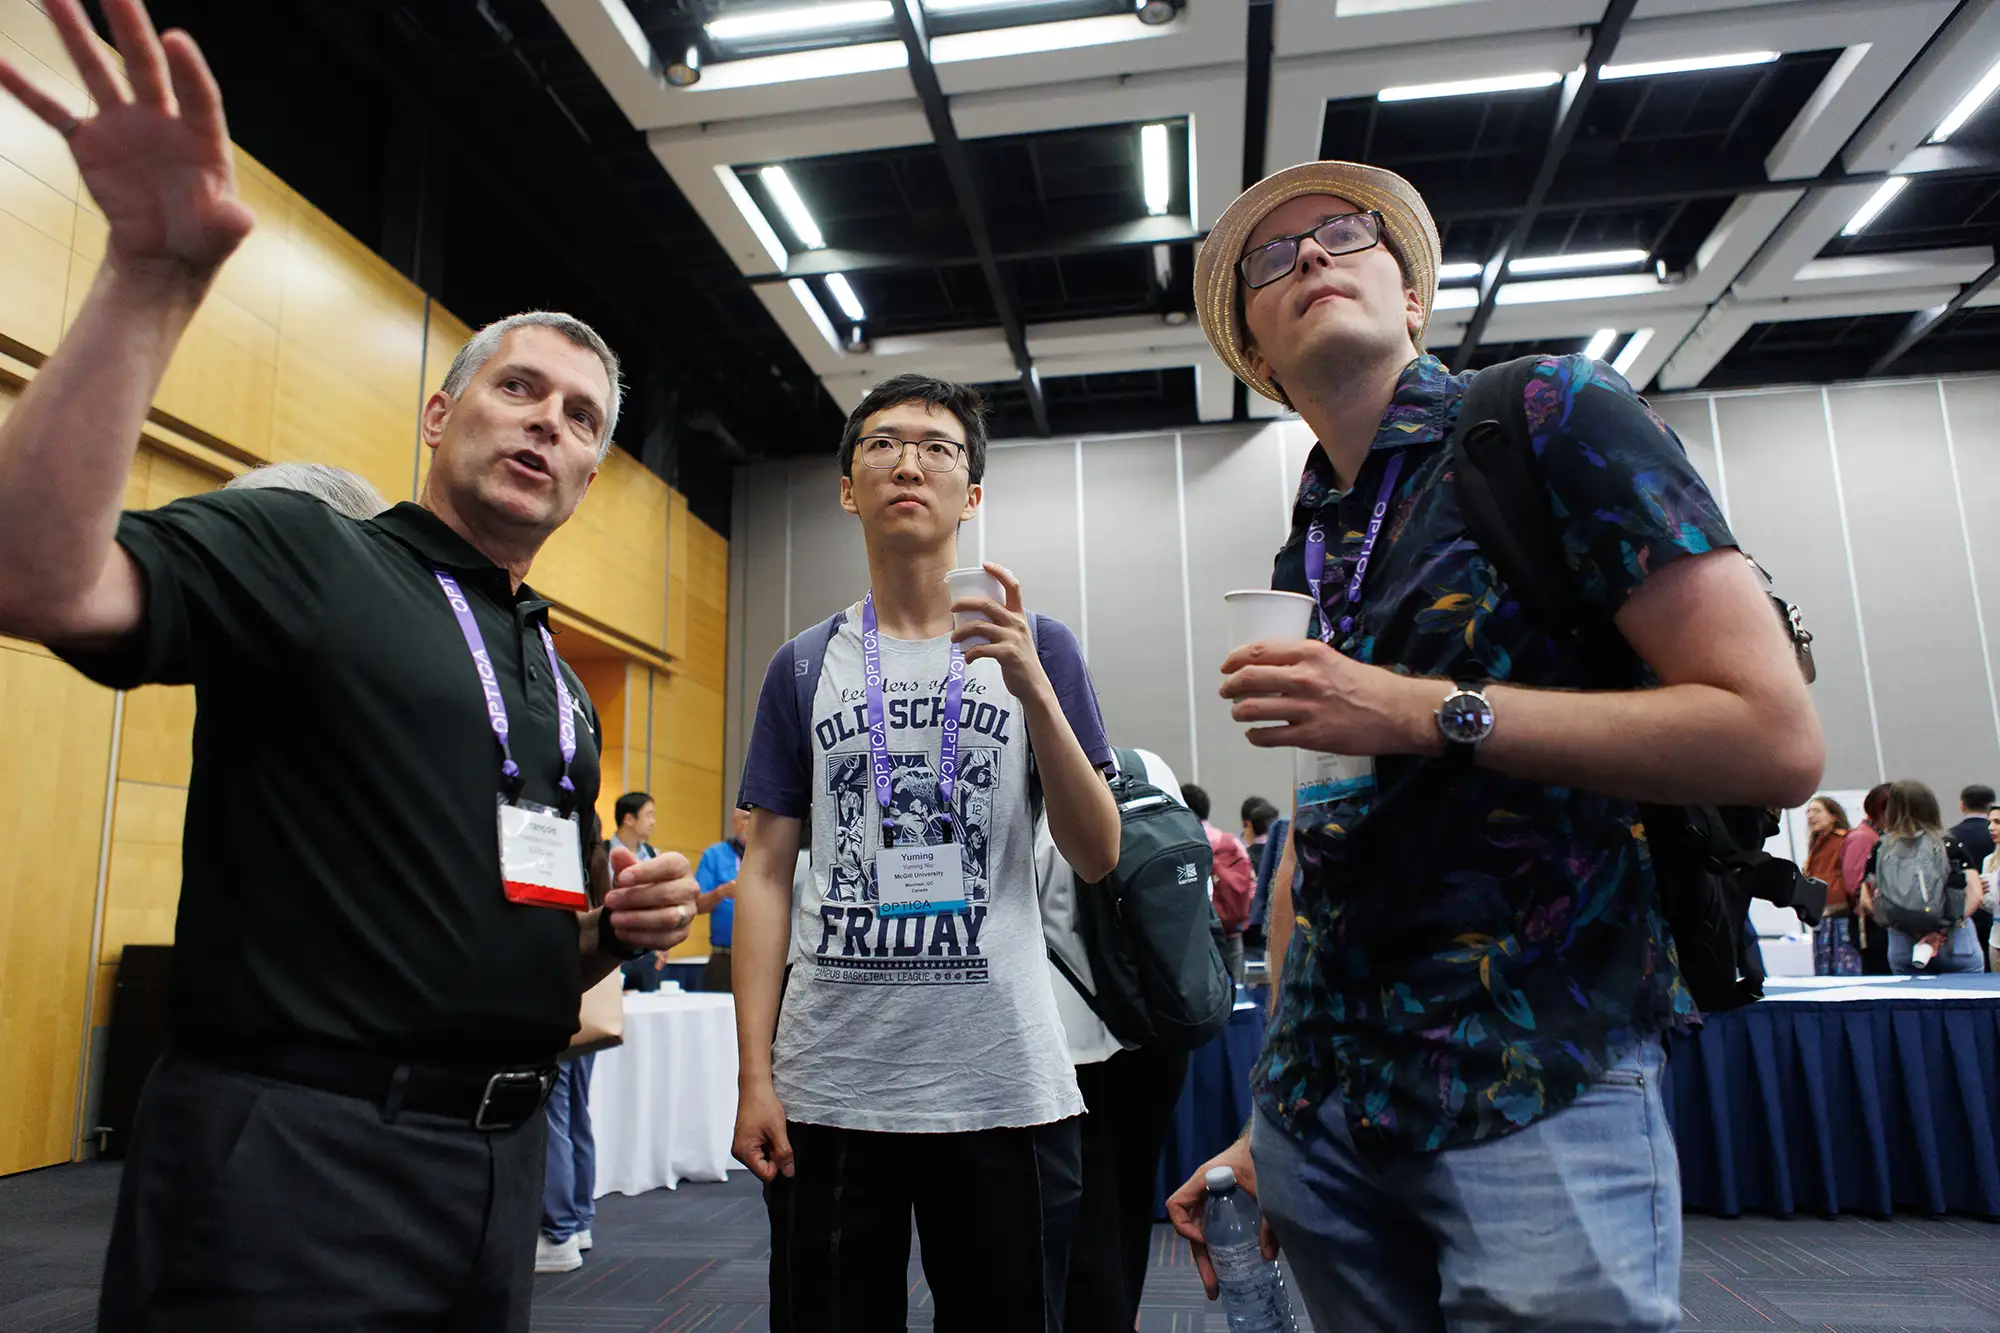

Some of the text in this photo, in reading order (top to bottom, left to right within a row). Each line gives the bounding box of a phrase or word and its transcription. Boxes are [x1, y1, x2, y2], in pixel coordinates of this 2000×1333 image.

[1351, 502, 1386, 591] OPTICA
[436, 573, 469, 613] OPT
[864, 628, 880, 687] OPTICA
[950, 648, 965, 682] TICA
[472, 649, 509, 734] OPTICA
[963, 678, 987, 695] he
[556, 678, 577, 750] OPTICA
[815, 697, 1010, 751] OLD SCHOOL
[871, 721, 890, 788] OPTICA
[940, 718, 957, 786] OPTICA
[972, 804, 982, 816] 12
[901, 852, 934, 861] Yuming
[816, 905, 988, 957] FRIDAY
[881, 900, 932, 912] OPTICA
[843, 971, 894, 981] BASKETBALL
[897, 972, 930, 981] LEAGUE
